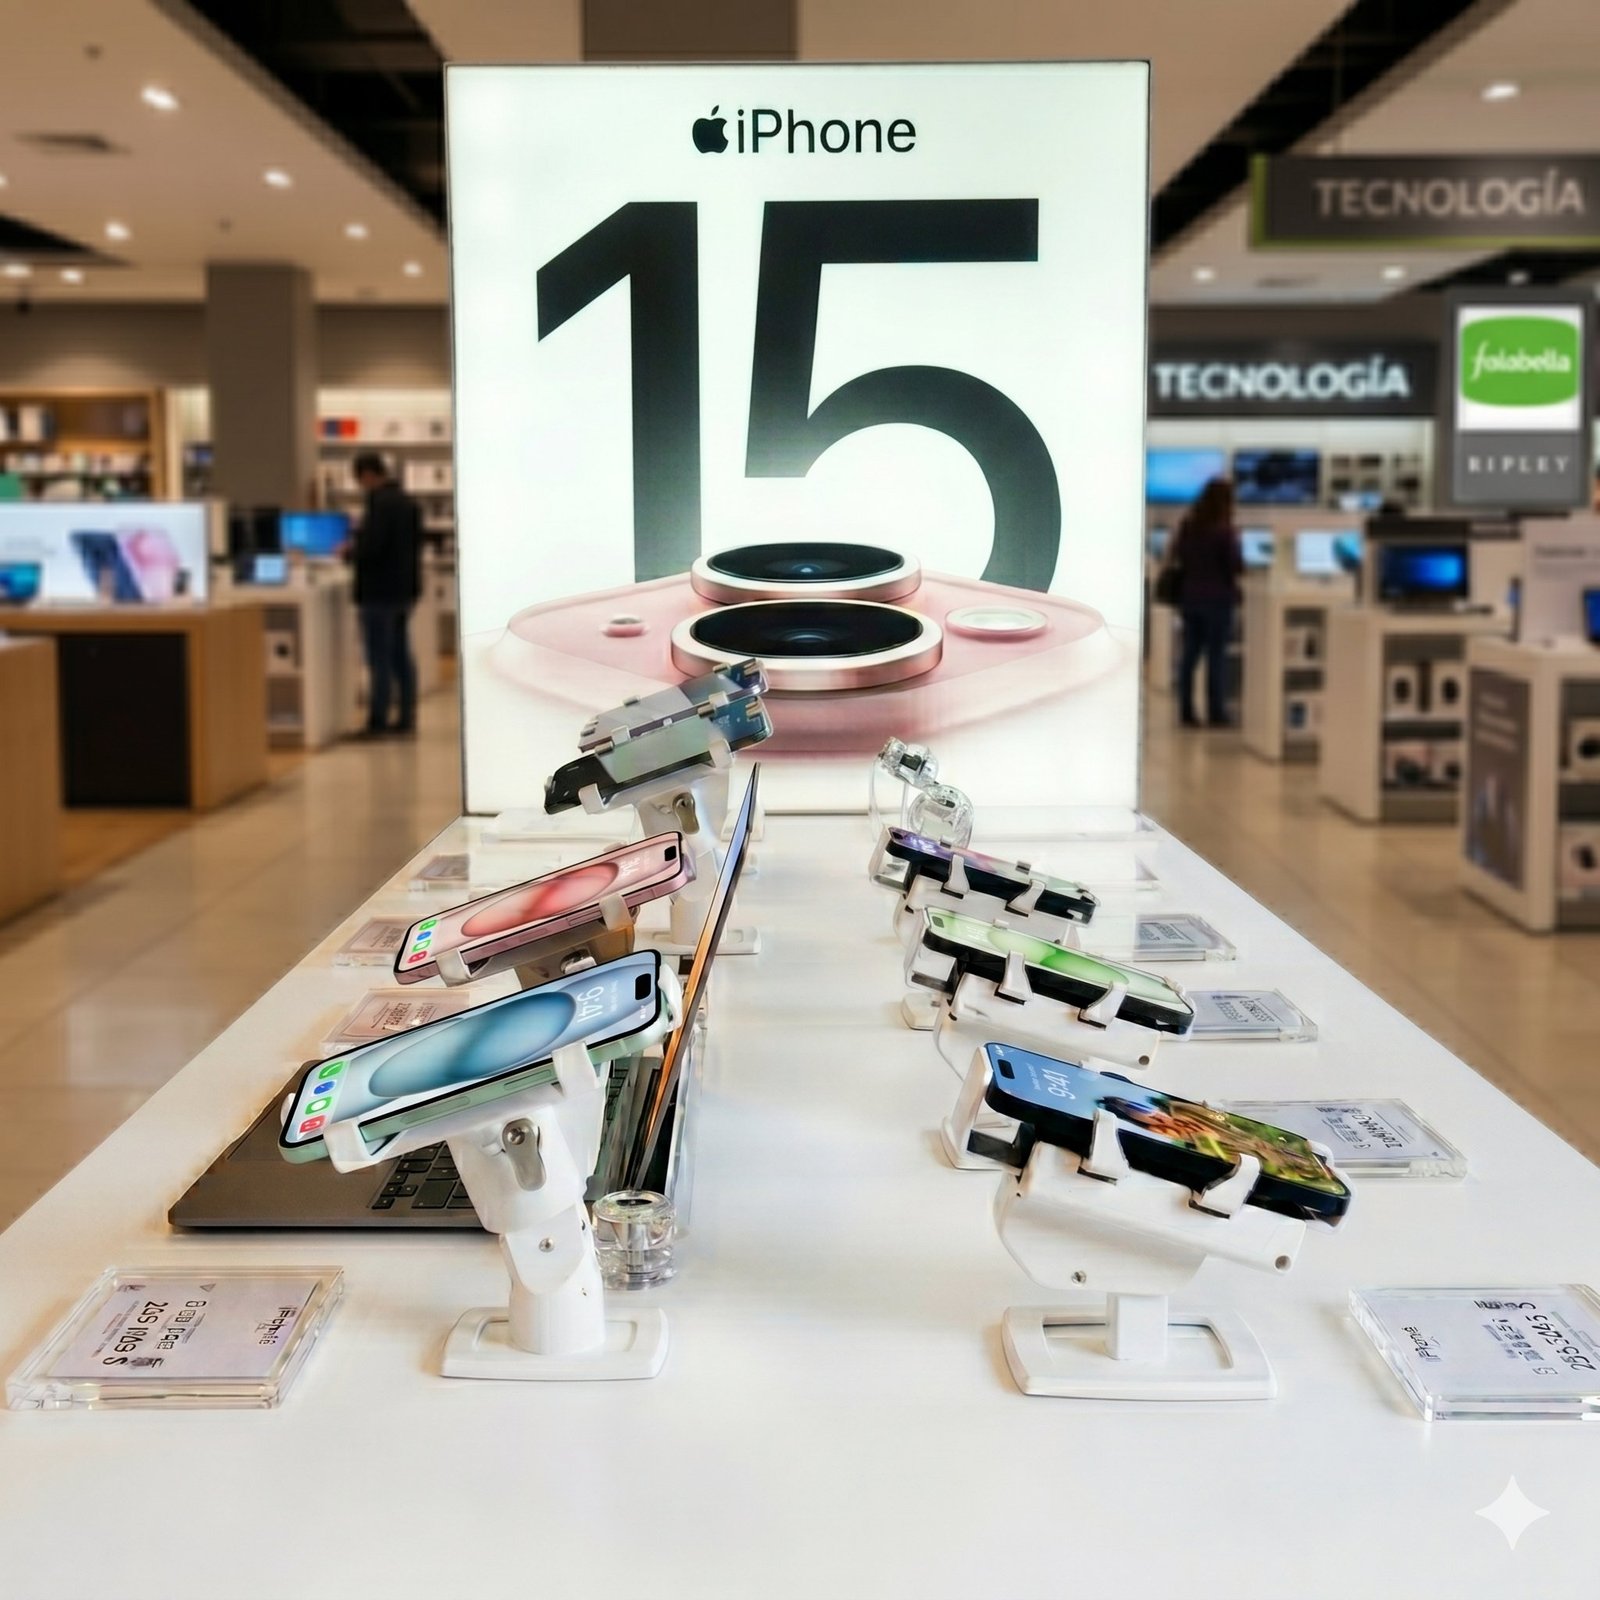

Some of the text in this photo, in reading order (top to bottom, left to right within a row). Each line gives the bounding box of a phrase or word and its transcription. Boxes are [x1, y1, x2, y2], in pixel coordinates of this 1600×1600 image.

[737, 108, 917, 154] iPhone
[1315, 168, 1585, 219] TECNOLOGÍA
[536, 198, 1062, 593] 15
[1154, 354, 1411, 399] TECNOLOGÍA
[1467, 454, 1569, 474] RIPLEY
[576, 986, 604, 1023] 9:41
[1041, 1067, 1076, 1099] 9:41
